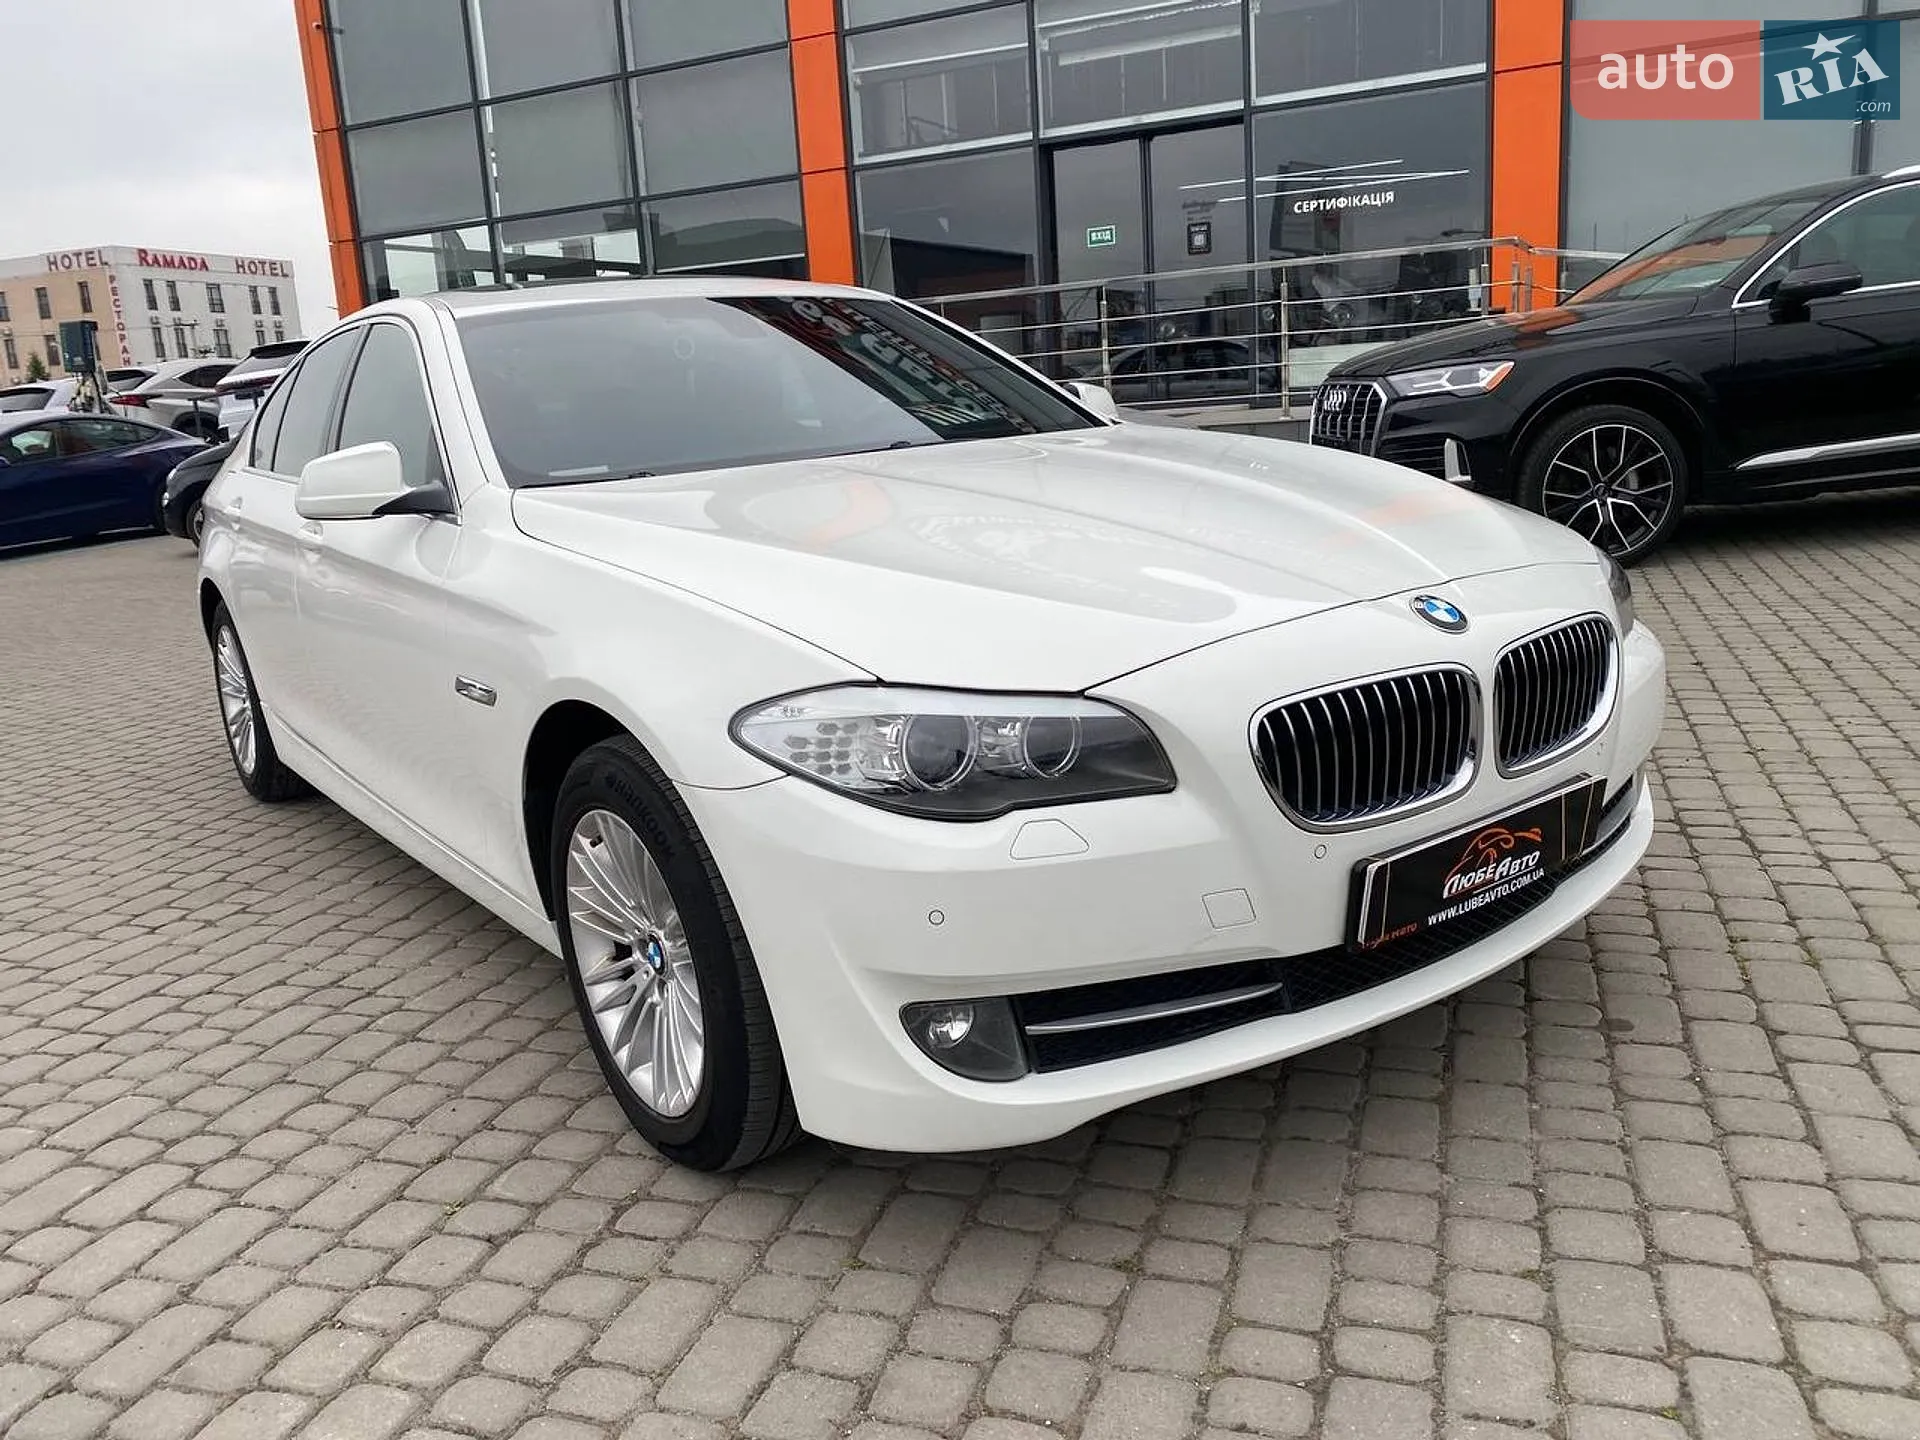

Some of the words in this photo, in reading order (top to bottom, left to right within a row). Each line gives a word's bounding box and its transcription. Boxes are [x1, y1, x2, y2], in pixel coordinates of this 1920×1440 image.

[1293, 191, 1395, 214] СЕРТИФІКАЦІЯ
[46, 249, 111, 272] HOTEL
[235, 259, 289, 278] HOTEL
[1427, 867, 1545, 926] WWW.LUBEAVTO.COM.UA
